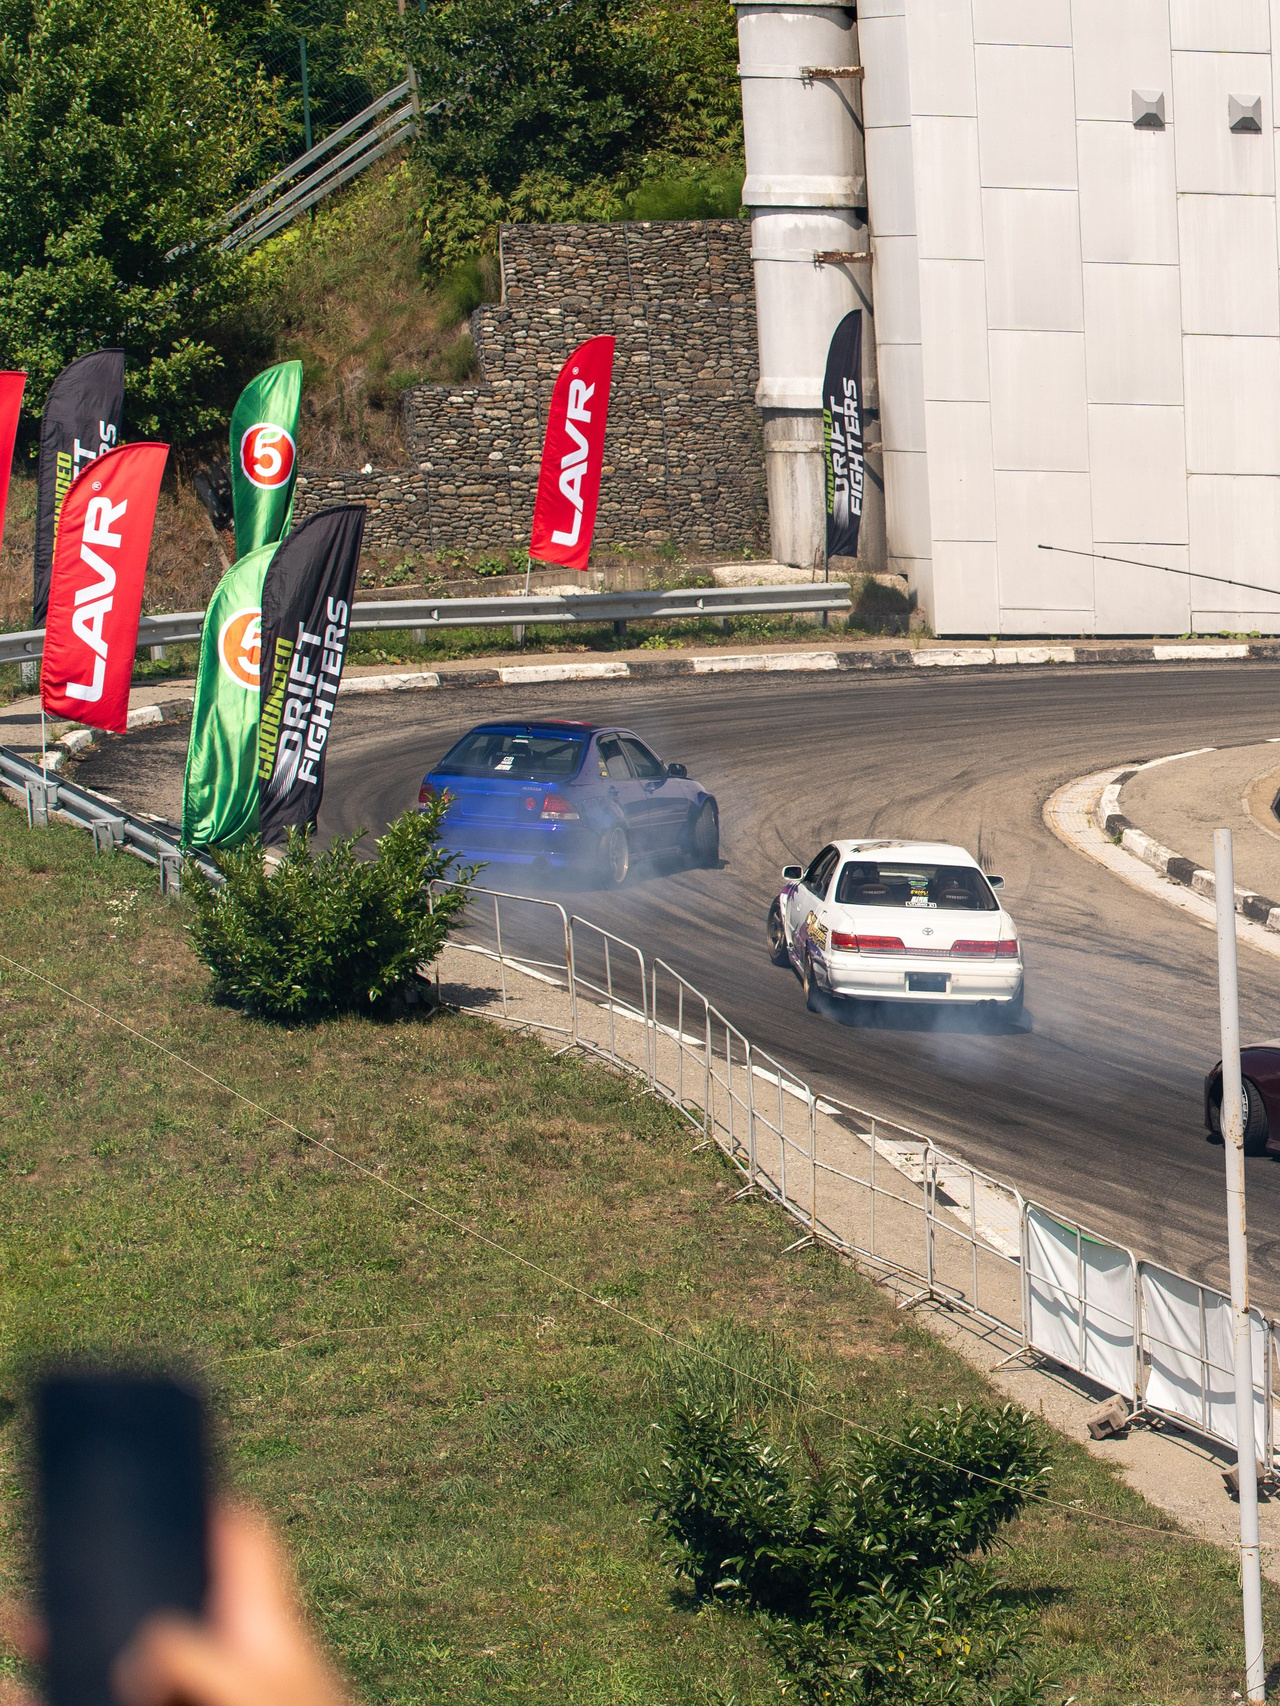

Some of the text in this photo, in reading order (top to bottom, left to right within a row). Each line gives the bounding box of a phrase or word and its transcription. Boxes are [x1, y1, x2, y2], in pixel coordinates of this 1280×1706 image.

[829, 395, 850, 530] DRIFT
[842, 377, 864, 517] FIGHTERS
[258, 637, 294, 781] GROUNDED
[268, 621, 322, 800] DRIFT
[298, 596, 349, 785] FIGHTERS
